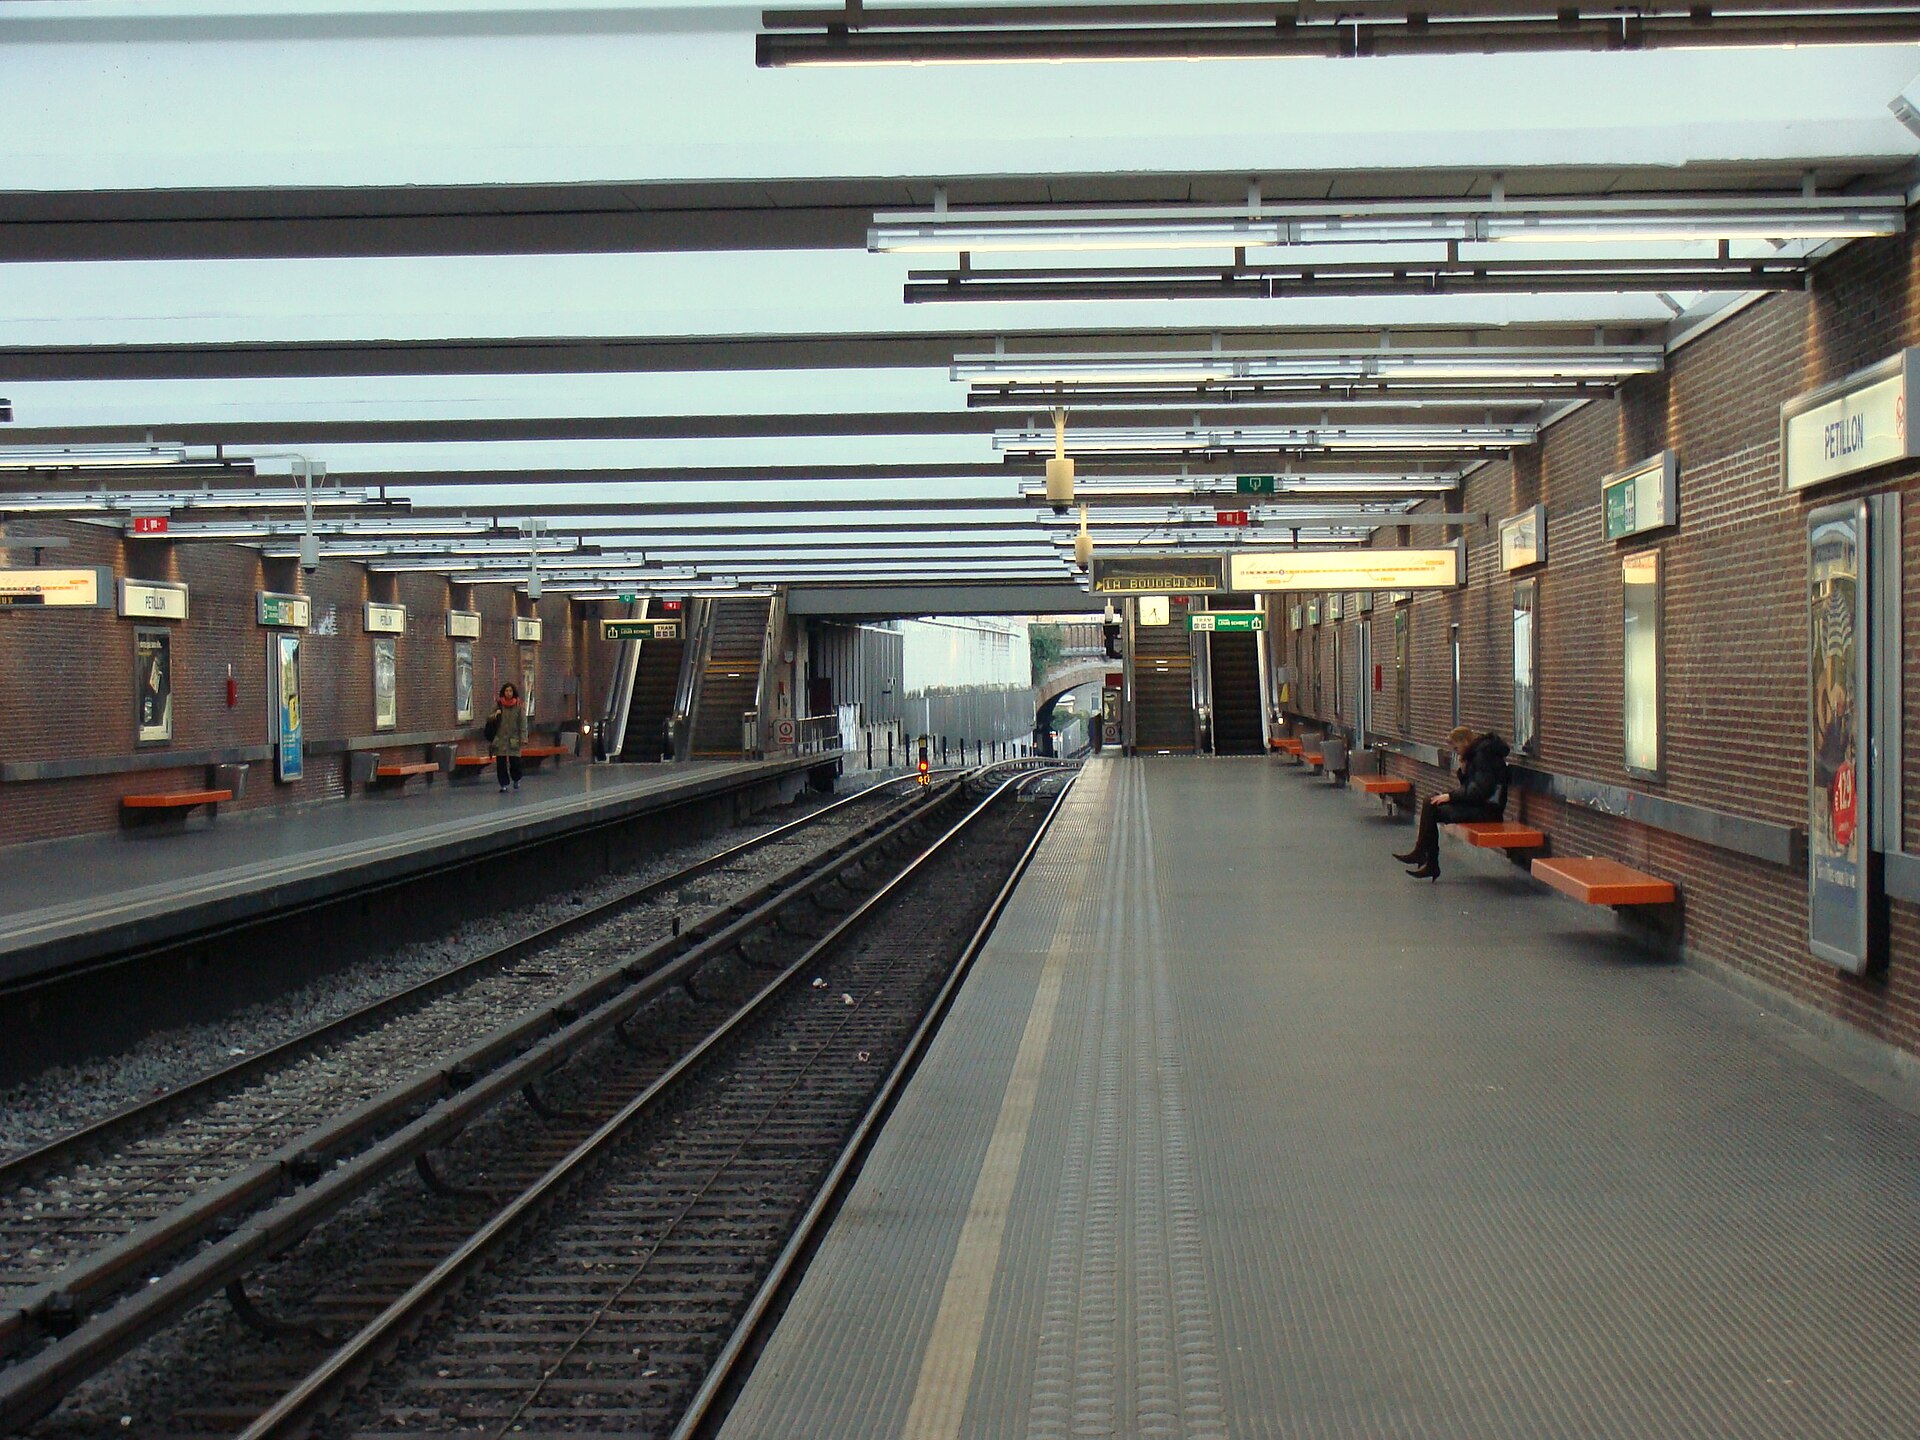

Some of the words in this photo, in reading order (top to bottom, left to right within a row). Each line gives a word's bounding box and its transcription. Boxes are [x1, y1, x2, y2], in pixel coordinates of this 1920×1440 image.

[1824, 413, 1864, 460] PETILLON
[1105, 578, 1120, 589] 1A
[1130, 577, 1207, 589] BOUDEWIJN
[0, 597, 13, 605] UX
[145, 596, 166, 610] PETILLON
